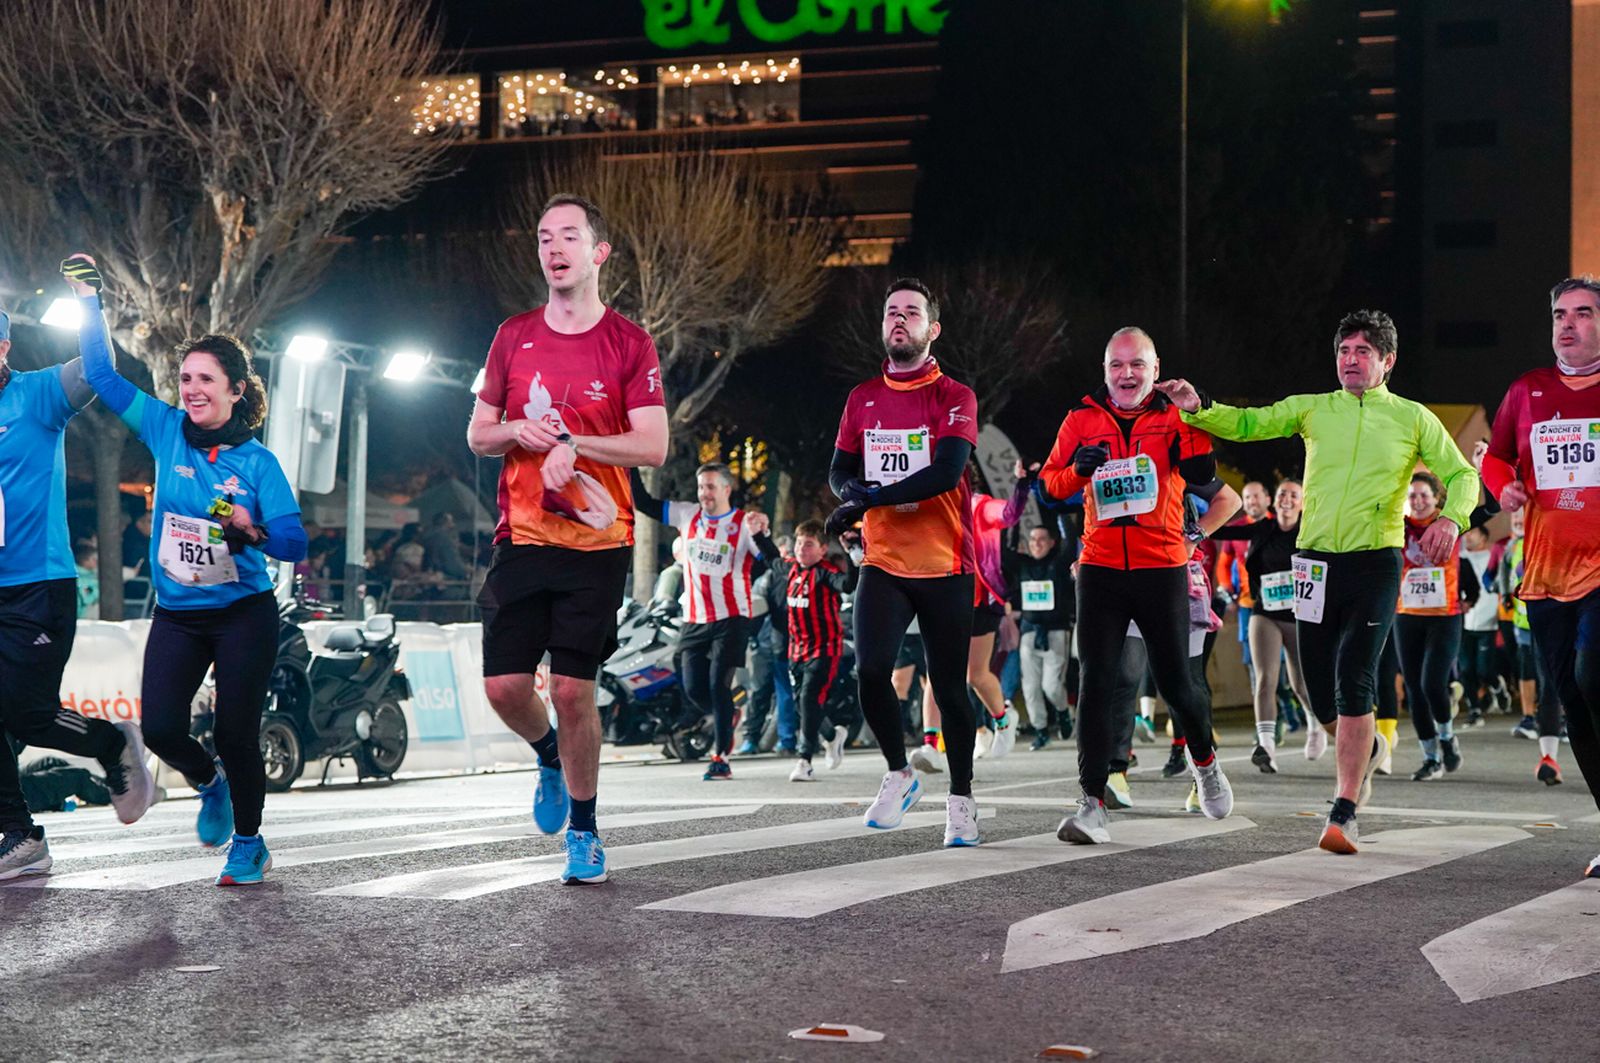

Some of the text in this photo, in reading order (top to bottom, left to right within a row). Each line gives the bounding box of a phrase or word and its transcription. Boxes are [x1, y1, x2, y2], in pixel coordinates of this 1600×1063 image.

[1539, 435, 1554, 444] SAN
[881, 452, 909, 472] 270
[1547, 442, 1595, 465] 5136
[1102, 475, 1146, 498] 8333
[179, 541, 215, 565] 1521
[698, 550, 723, 565] 4908
[1410, 582, 1436, 594] 7294
